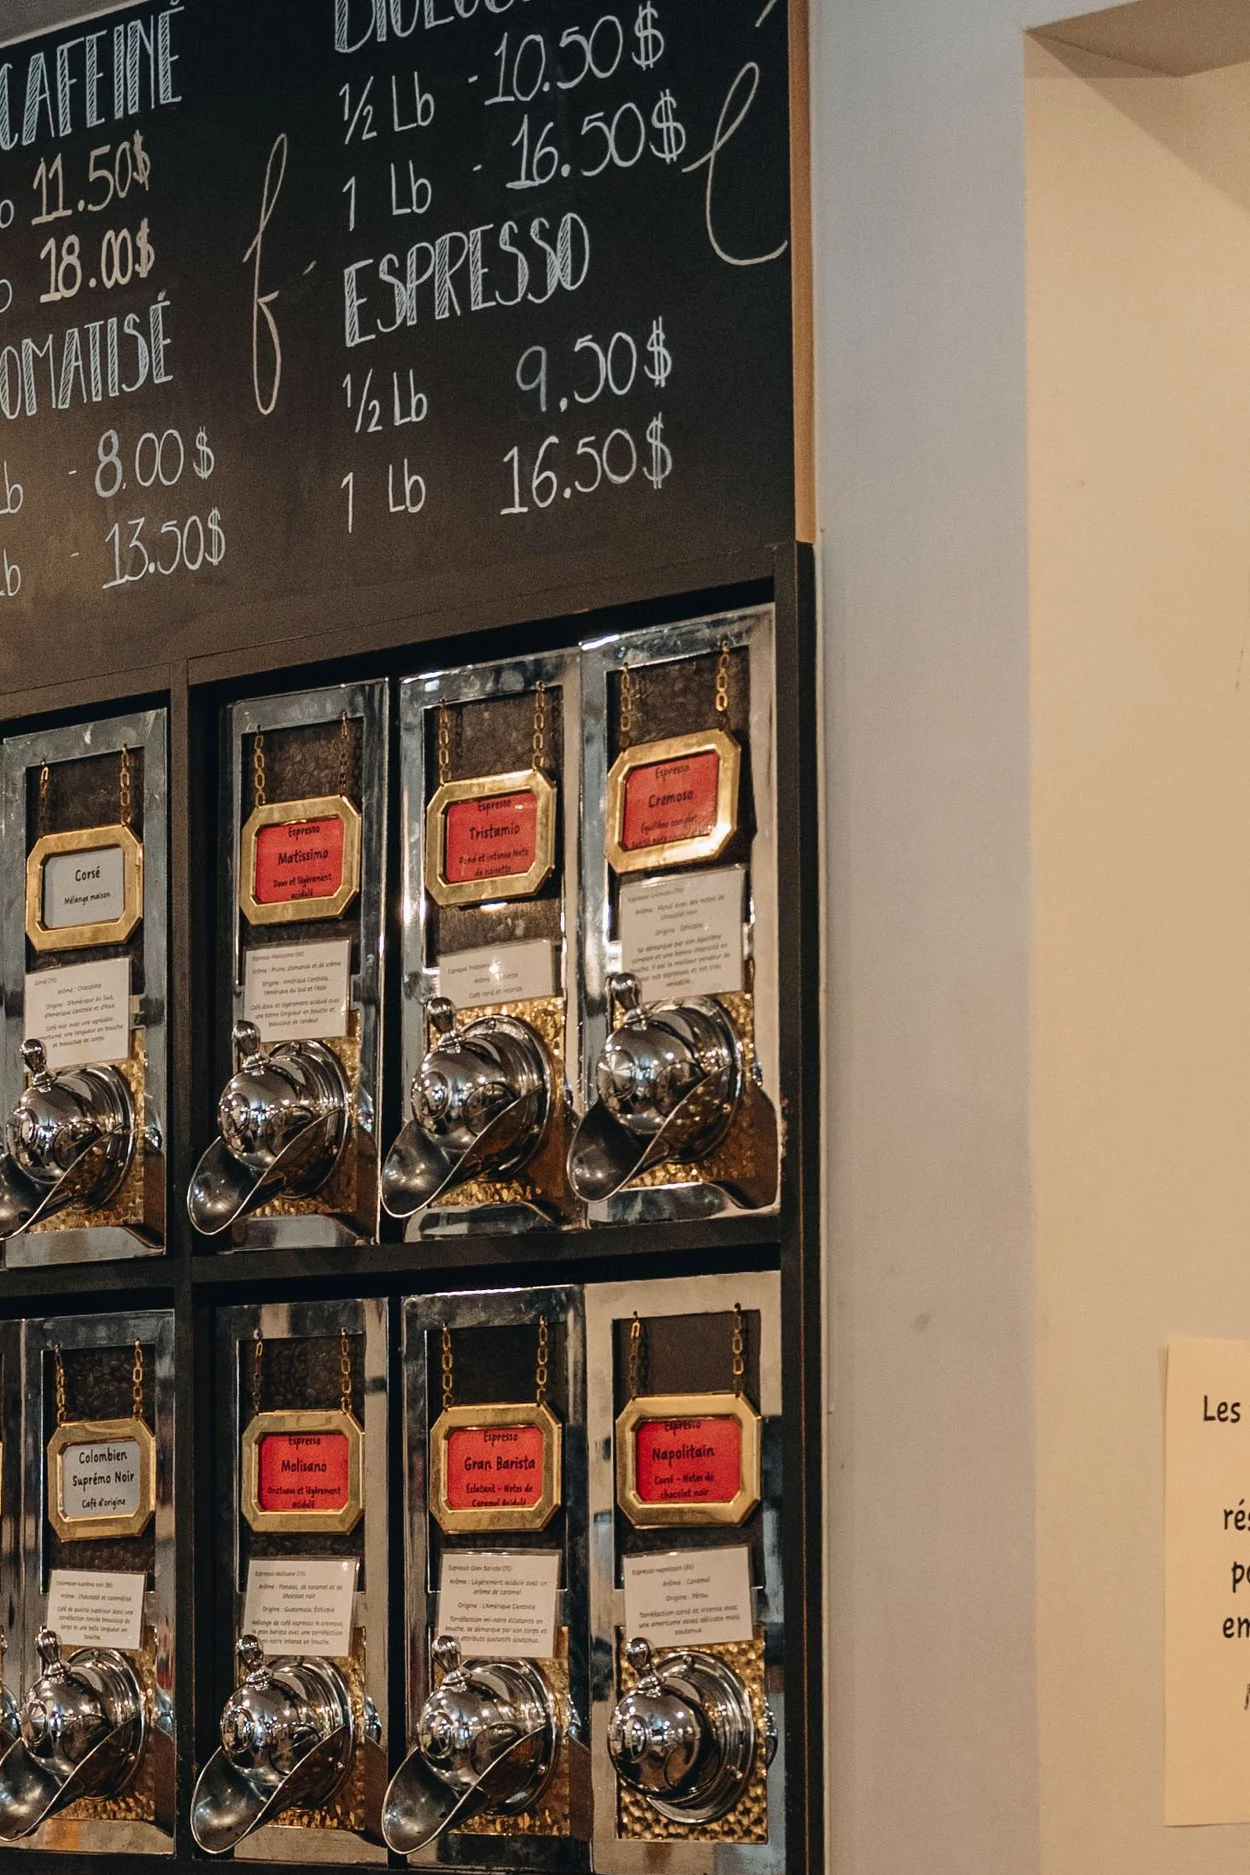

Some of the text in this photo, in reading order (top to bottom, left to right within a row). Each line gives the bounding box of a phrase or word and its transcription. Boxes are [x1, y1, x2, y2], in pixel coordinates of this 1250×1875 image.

[392, 72, 434, 132] Lb
[485, 3, 665, 105] 10.50$
[342, 89, 686, 231] 1 Lb 16.50$
[31, 129, 150, 226] 11.50$
[39, 217, 155, 303] 18.00$
[343, 213, 590, 347] ESPRESSO
[391, 370, 429, 424] Lb
[515, 315, 673, 413] 9.50$
[93, 425, 216, 500] 8.00$
[340, 411, 673, 533] 1 Lb 16.50$
[103, 506, 227, 590] 13.50$
[655, 764, 691, 781] Espresso
[477, 800, 511, 816] Espresso
[648, 790, 694, 809] Cremoso
[288, 826, 320, 840] Espresso
[278, 848, 328, 866] Matissimo
[75, 866, 101, 882] Corsé
[64, 891, 111, 906] Mélange maison
[1203, 1395, 1241, 1423] Les
[483, 1431, 518, 1447] Espresso
[78, 1447, 127, 1464] Colombien
[281, 1457, 327, 1472] Molisano
[464, 1455, 535, 1471] Gran Barista
[652, 1444, 715, 1468] Napolitain
[72, 1470, 135, 1491] Suprémo Noir
[82, 1498, 126, 1511] Café d'origine
